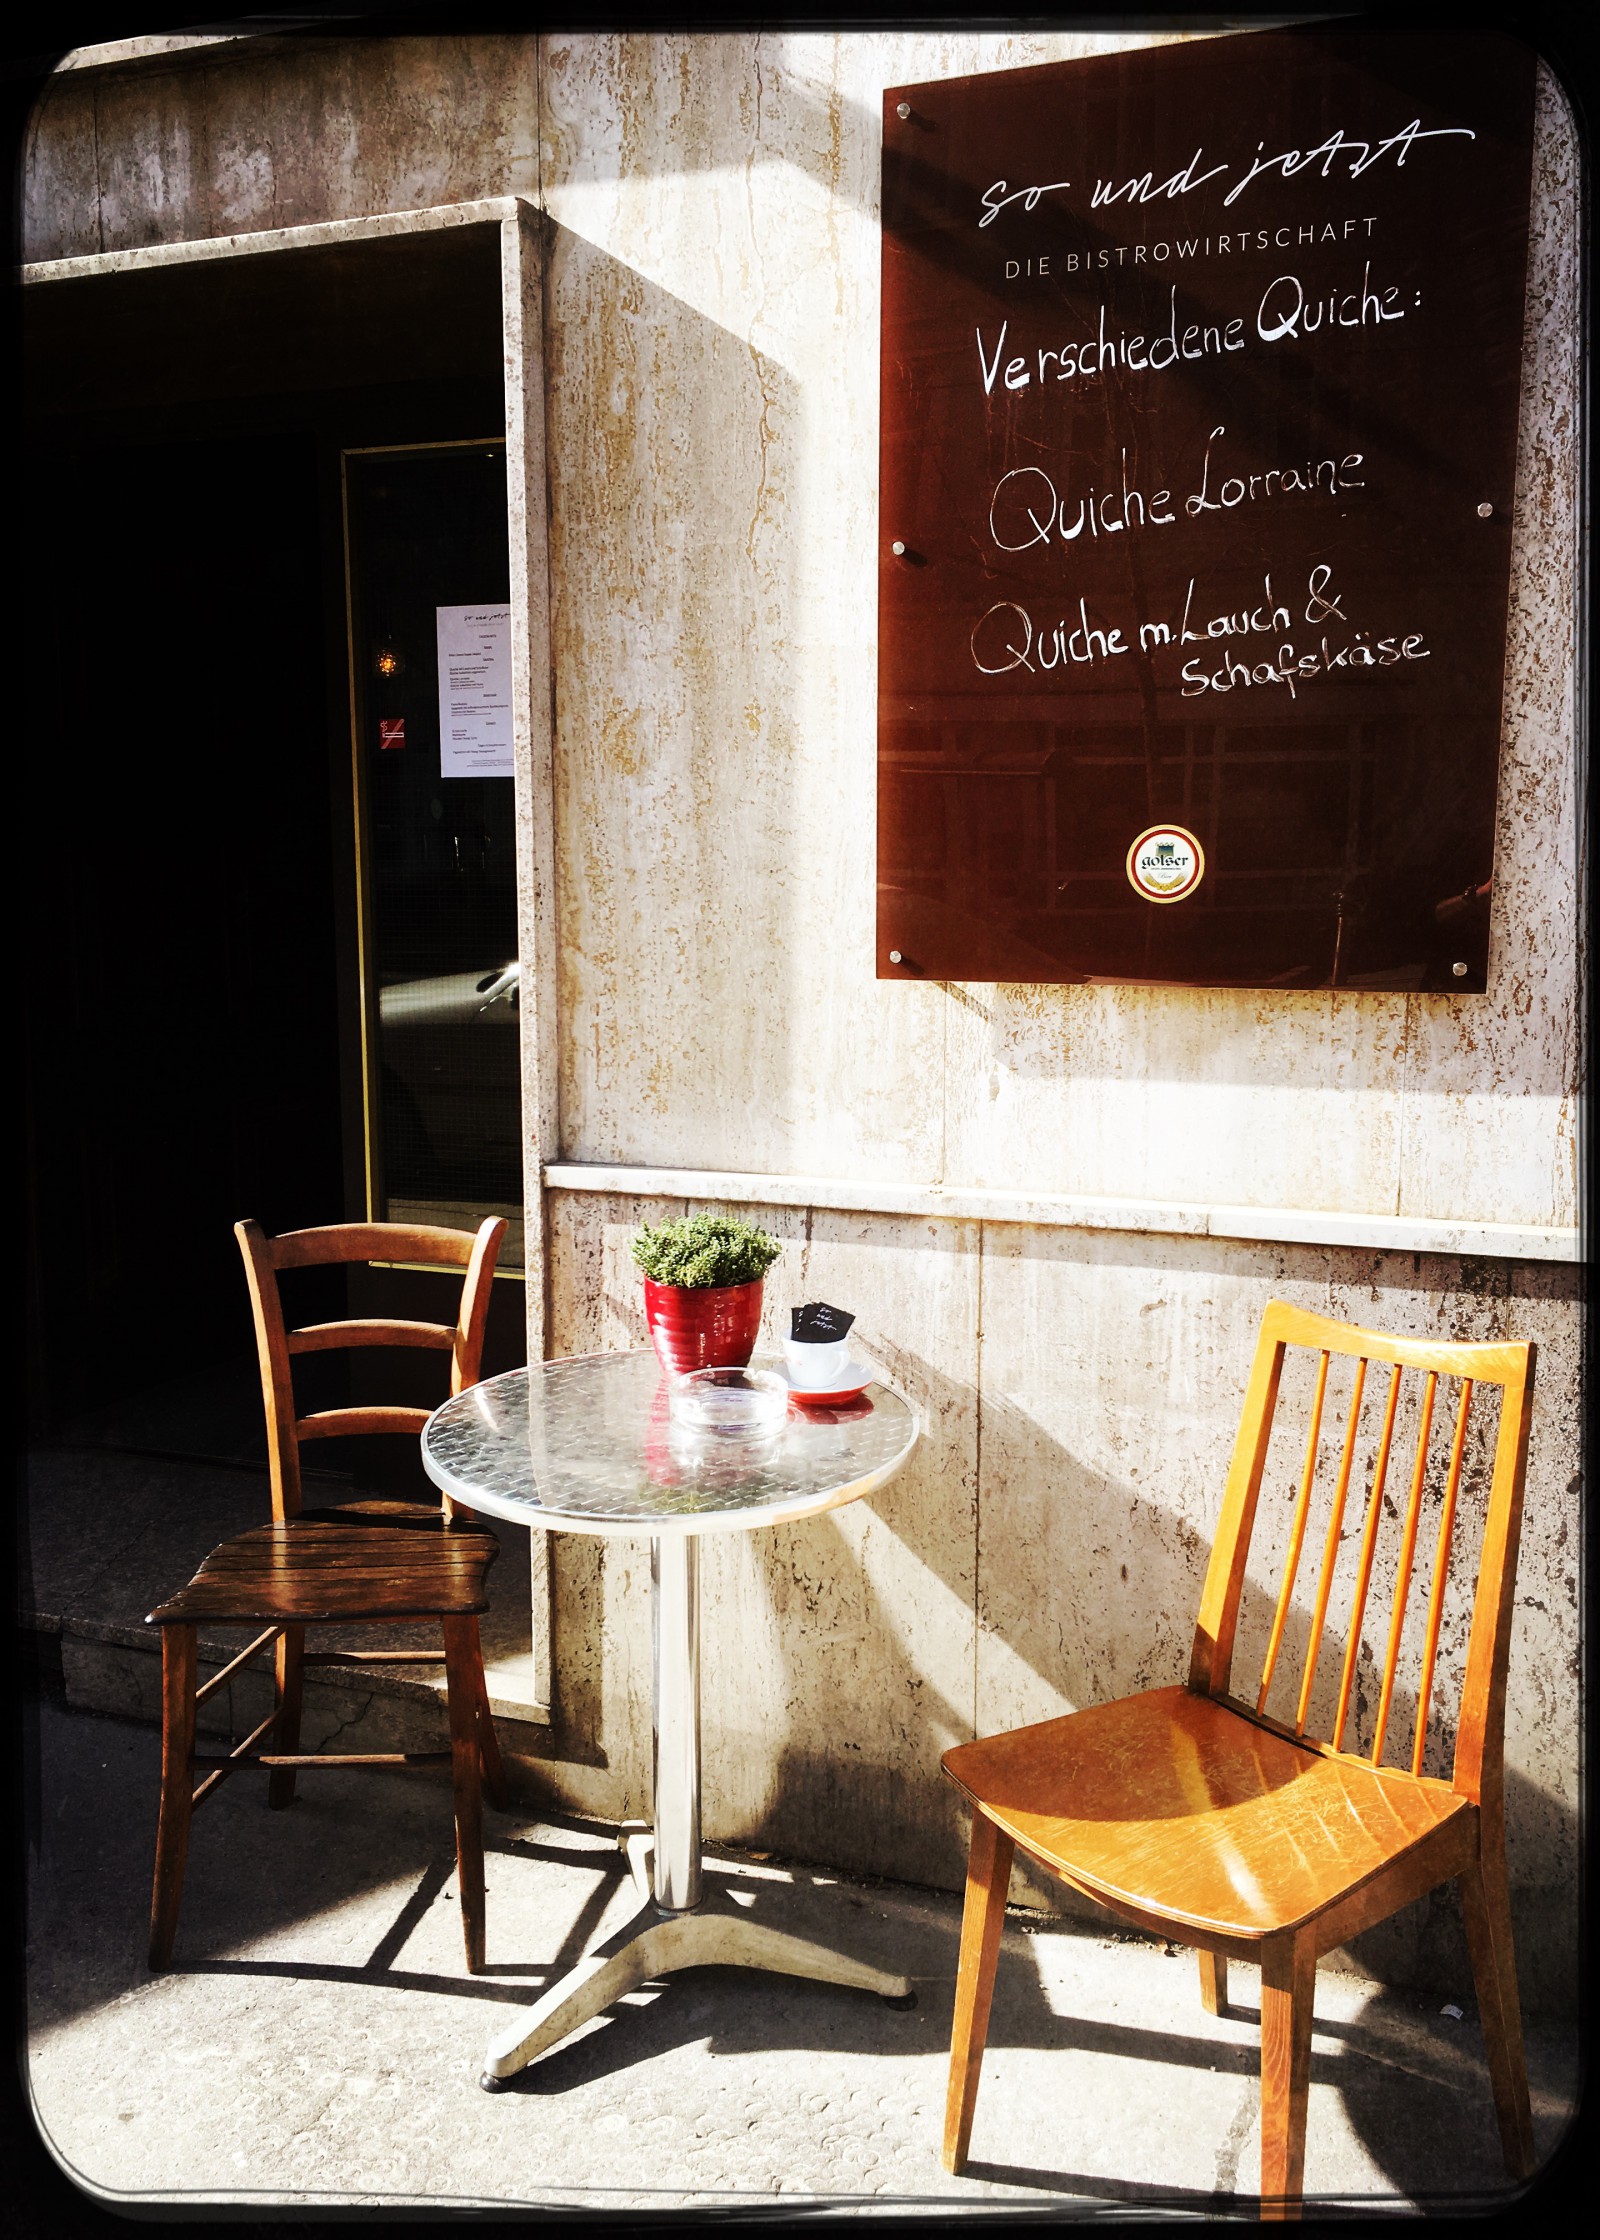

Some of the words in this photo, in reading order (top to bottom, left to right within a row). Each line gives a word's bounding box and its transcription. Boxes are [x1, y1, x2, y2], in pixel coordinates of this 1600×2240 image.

[978, 180, 1070, 228] so
[1091, 148, 1229, 208] und
[1223, 118, 1476, 206] jetzt
[1005, 256, 1051, 279] DIE
[1066, 217, 1379, 272] BISTROWIRTSCHAFT
[976, 285, 1246, 397] Verschiedene
[989, 447, 1176, 552] Quiche
[1185, 426, 1366, 517] Lorraine
[970, 597, 1129, 675] Quiche
[1304, 564, 1347, 624] &
[1180, 631, 1431, 699] Schafskäse
